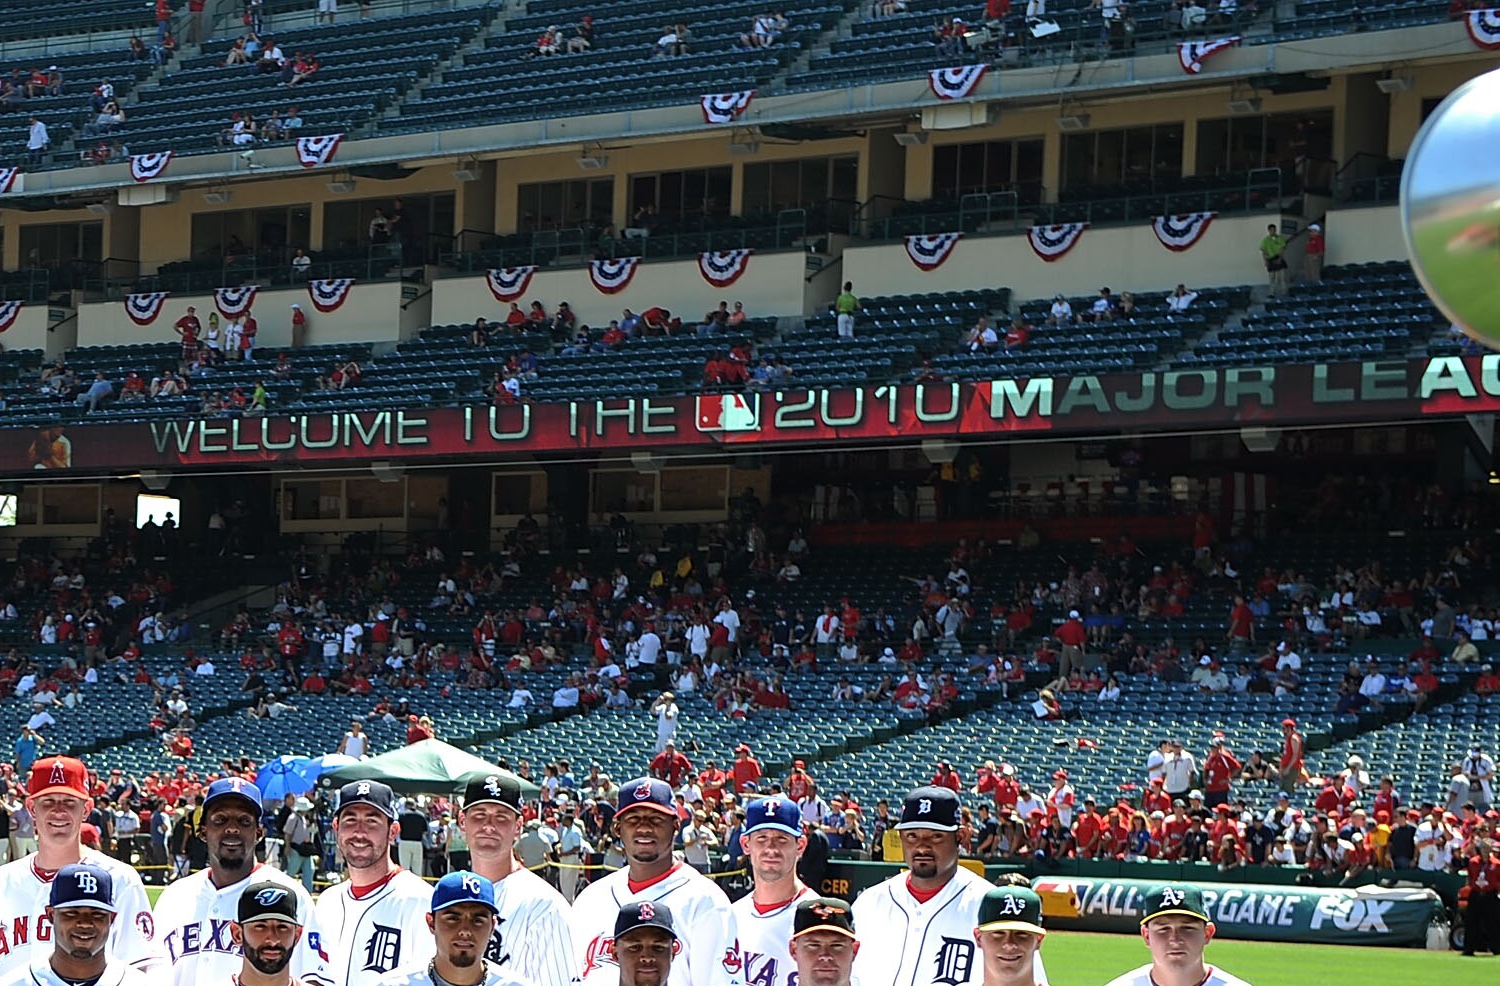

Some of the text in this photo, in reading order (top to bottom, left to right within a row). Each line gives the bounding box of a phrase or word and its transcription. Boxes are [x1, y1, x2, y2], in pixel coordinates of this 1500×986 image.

[774, 382, 959, 429] 2010
[989, 366, 1276, 419] MAJOR
[149, 411, 428, 454] WELCOME
[1309, 892, 1394, 934] FOX
[163, 918, 246, 963] TEXA
[931, 935, 977, 986] D
